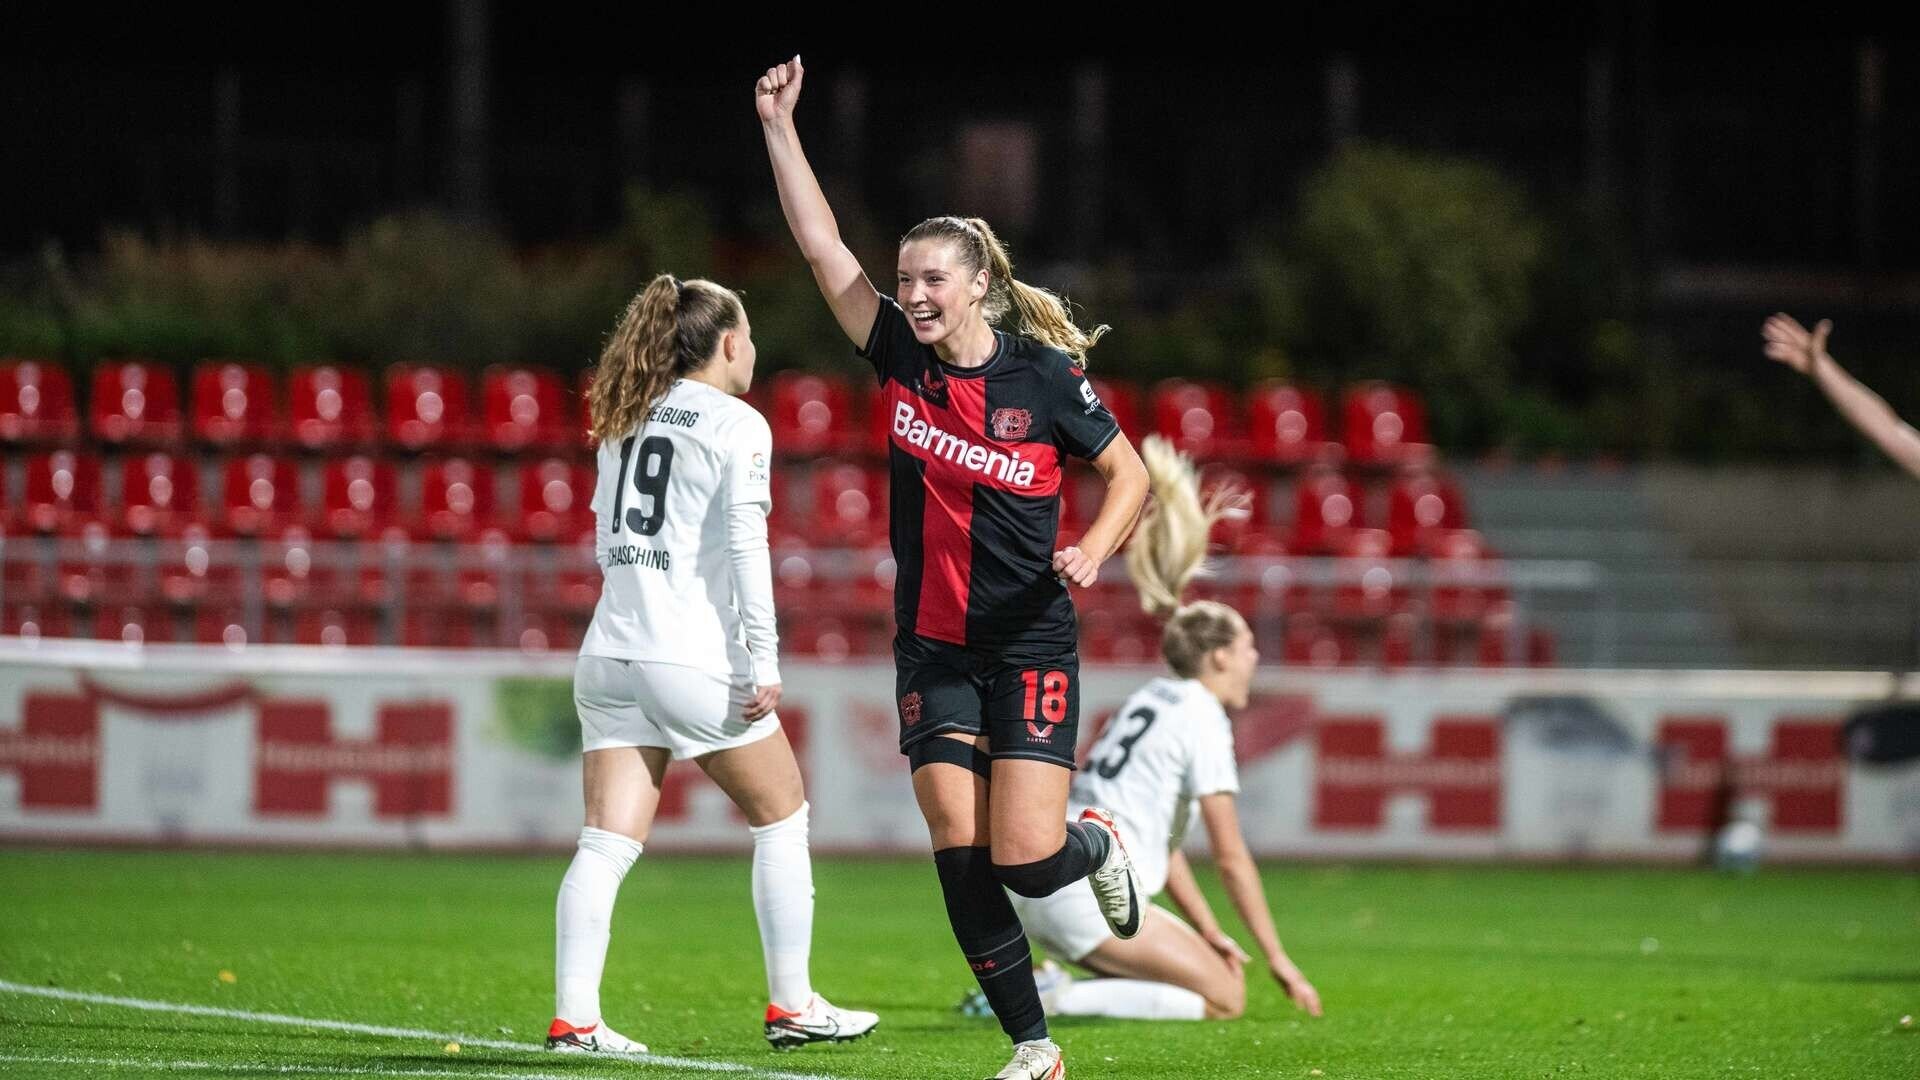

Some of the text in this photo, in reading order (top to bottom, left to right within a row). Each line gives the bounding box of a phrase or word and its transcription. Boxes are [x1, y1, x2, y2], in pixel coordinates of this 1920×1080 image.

[647, 406, 699, 428] EIBURG
[894, 401, 1036, 486] Barmenia
[612, 435, 675, 535] 19
[749, 470, 769, 481] Pix
[1021, 670, 1069, 723] 18
[1084, 707, 1156, 779] 3
